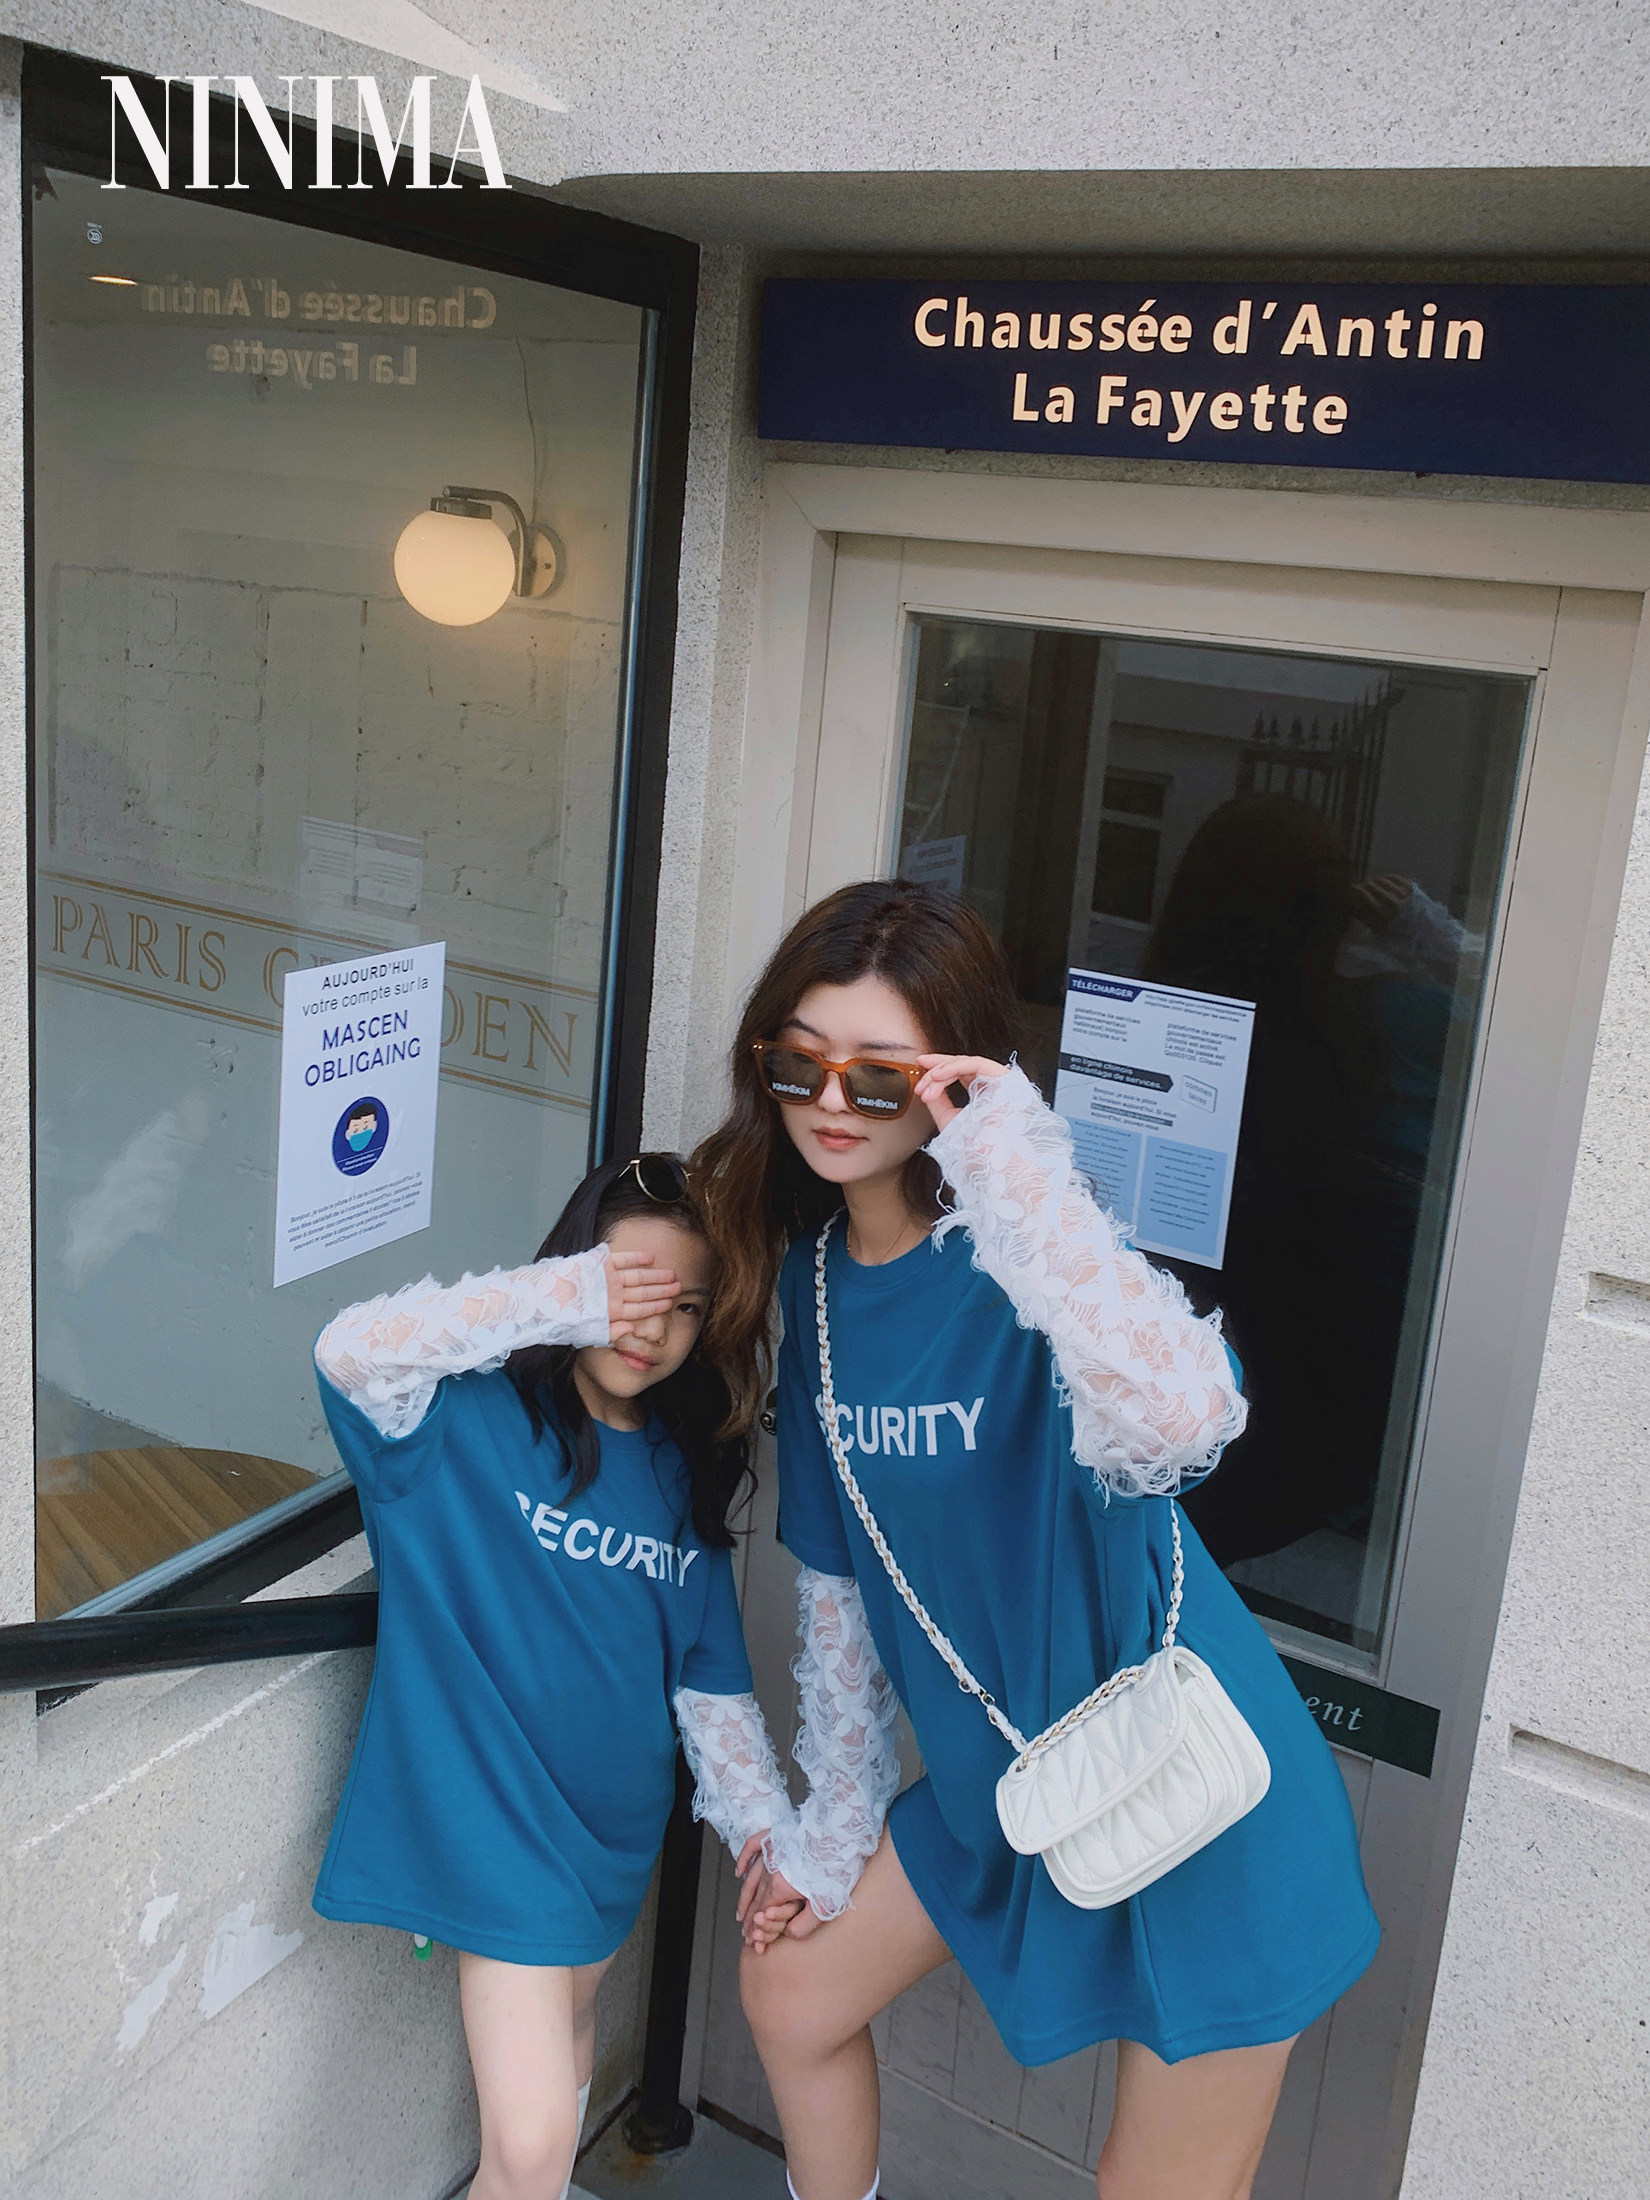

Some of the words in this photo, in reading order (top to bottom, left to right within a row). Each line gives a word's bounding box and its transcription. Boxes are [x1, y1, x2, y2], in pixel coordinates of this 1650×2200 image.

[914, 297, 1193, 353] Chaussée
[1212, 300, 1485, 360] d'Antin
[1012, 373, 1075, 424] La
[1096, 375, 1349, 443] Fayette
[52, 894, 226, 992] PARIS
[302, 996, 337, 1016] votre
[341, 983, 390, 1011] compte
[393, 979, 414, 995] sur
[417, 974, 428, 990] la
[321, 958, 413, 989] AUJOURD'HUI
[1071, 979, 1134, 999] TÉLÉCHARGER
[321, 1009, 407, 1050] MASCEN
[304, 1036, 421, 1088] OBLIGAING
[815, 1394, 985, 1457] CURITY
[1305, 1696, 1364, 1731] ent
